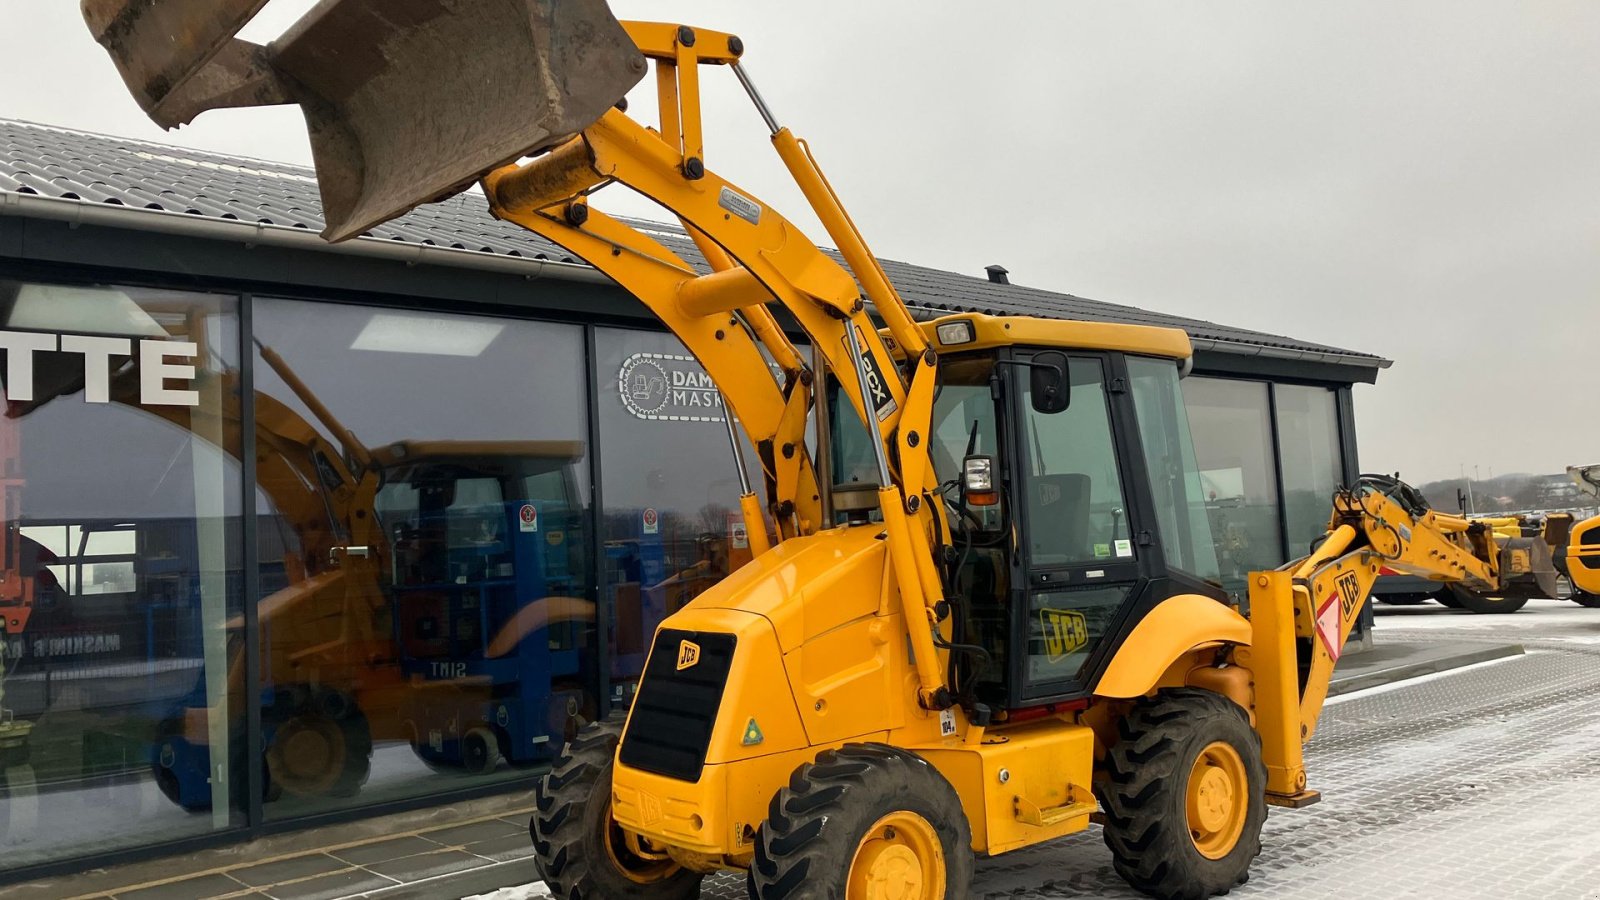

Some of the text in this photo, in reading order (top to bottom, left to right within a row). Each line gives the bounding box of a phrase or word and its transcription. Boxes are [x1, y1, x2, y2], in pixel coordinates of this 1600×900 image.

[881, 337, 897, 351] CB
[0, 331, 200, 405] TTE
[672, 371, 717, 388] DAM
[1338, 573, 1359, 616] JCB
[1048, 613, 1086, 657] JCB
[680, 645, 696, 665] JCB
[430, 661, 467, 679] TM12
